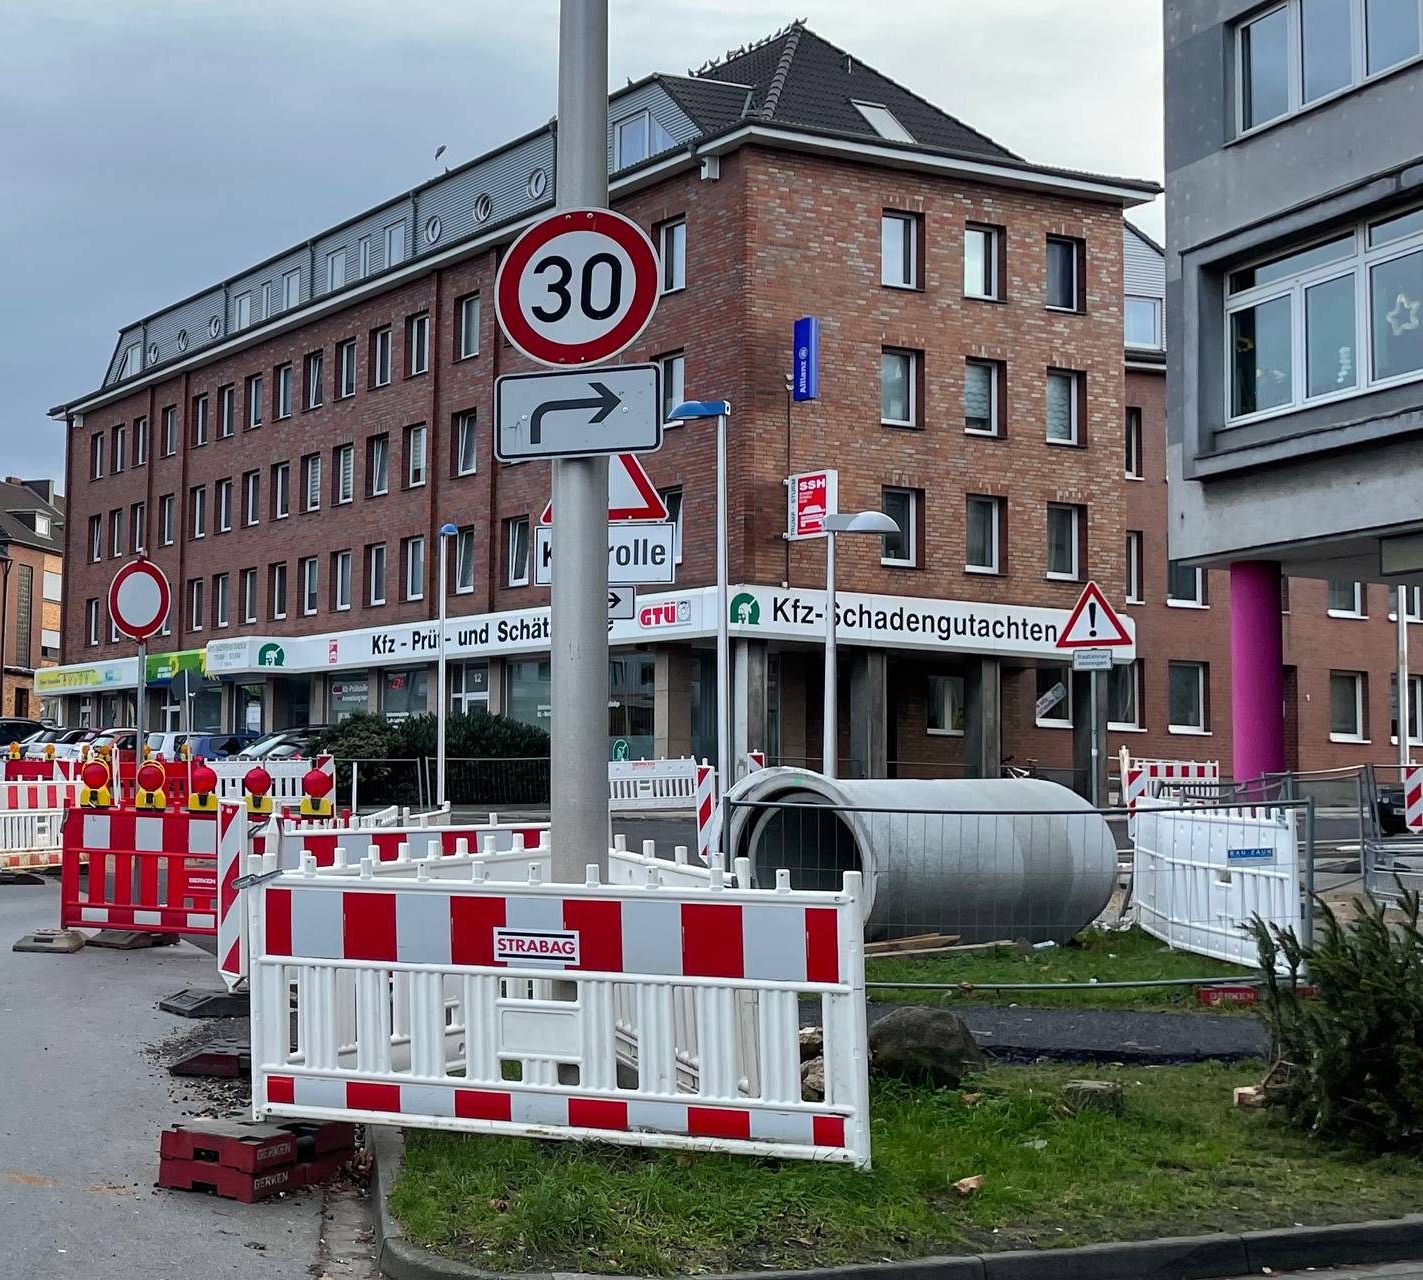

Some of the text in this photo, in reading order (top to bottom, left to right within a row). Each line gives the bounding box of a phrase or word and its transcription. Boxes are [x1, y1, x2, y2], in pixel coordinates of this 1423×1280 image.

[531, 252, 623, 323] 30
[799, 360, 807, 393] Allianz
[799, 478, 826, 491] SSH
[542, 538, 666, 567] Krolle
[640, 601, 676, 626] GTÜ
[772, 596, 1058, 642] Kfz-Schadengutachten
[372, 633, 396, 655] Kfz
[458, 622, 490, 647] und
[473, 673, 482, 683] 12
[497, 937, 576, 955] STRABAG
[256, 1142, 292, 1161] GERKEN
[253, 1171, 289, 1189] GERKEN
